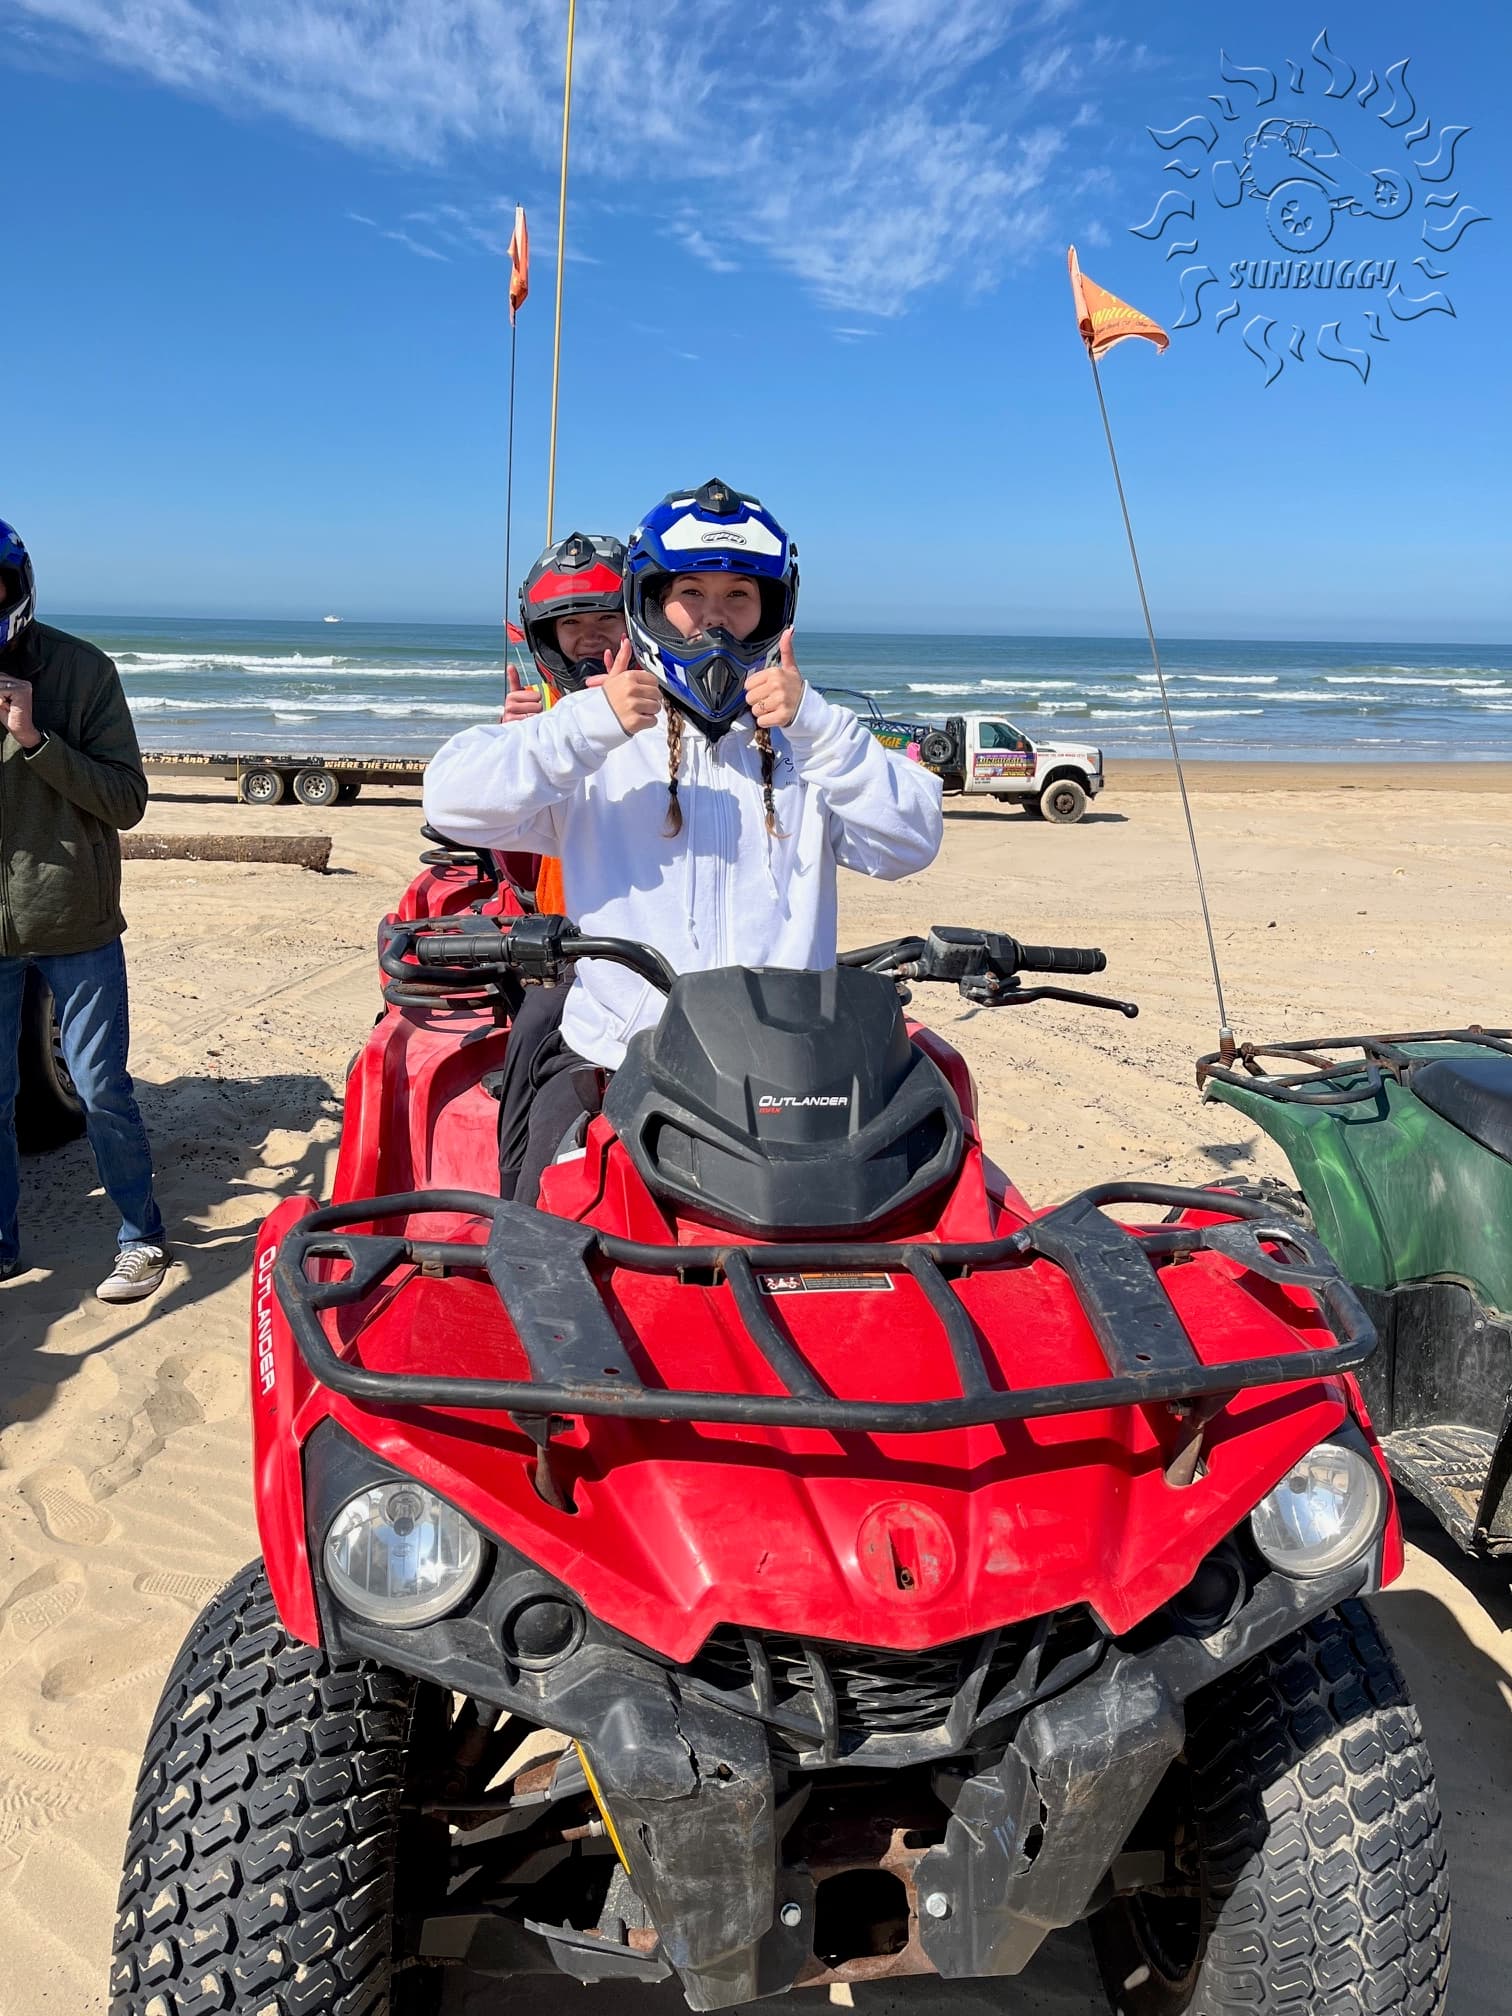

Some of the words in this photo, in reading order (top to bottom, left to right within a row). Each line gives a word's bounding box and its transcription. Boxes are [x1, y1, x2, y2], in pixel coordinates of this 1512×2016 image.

[405, 762, 428, 770] NEV
[759, 1095, 848, 1107] OUTLANDER
[257, 1245, 277, 1396] OUTLANDER
